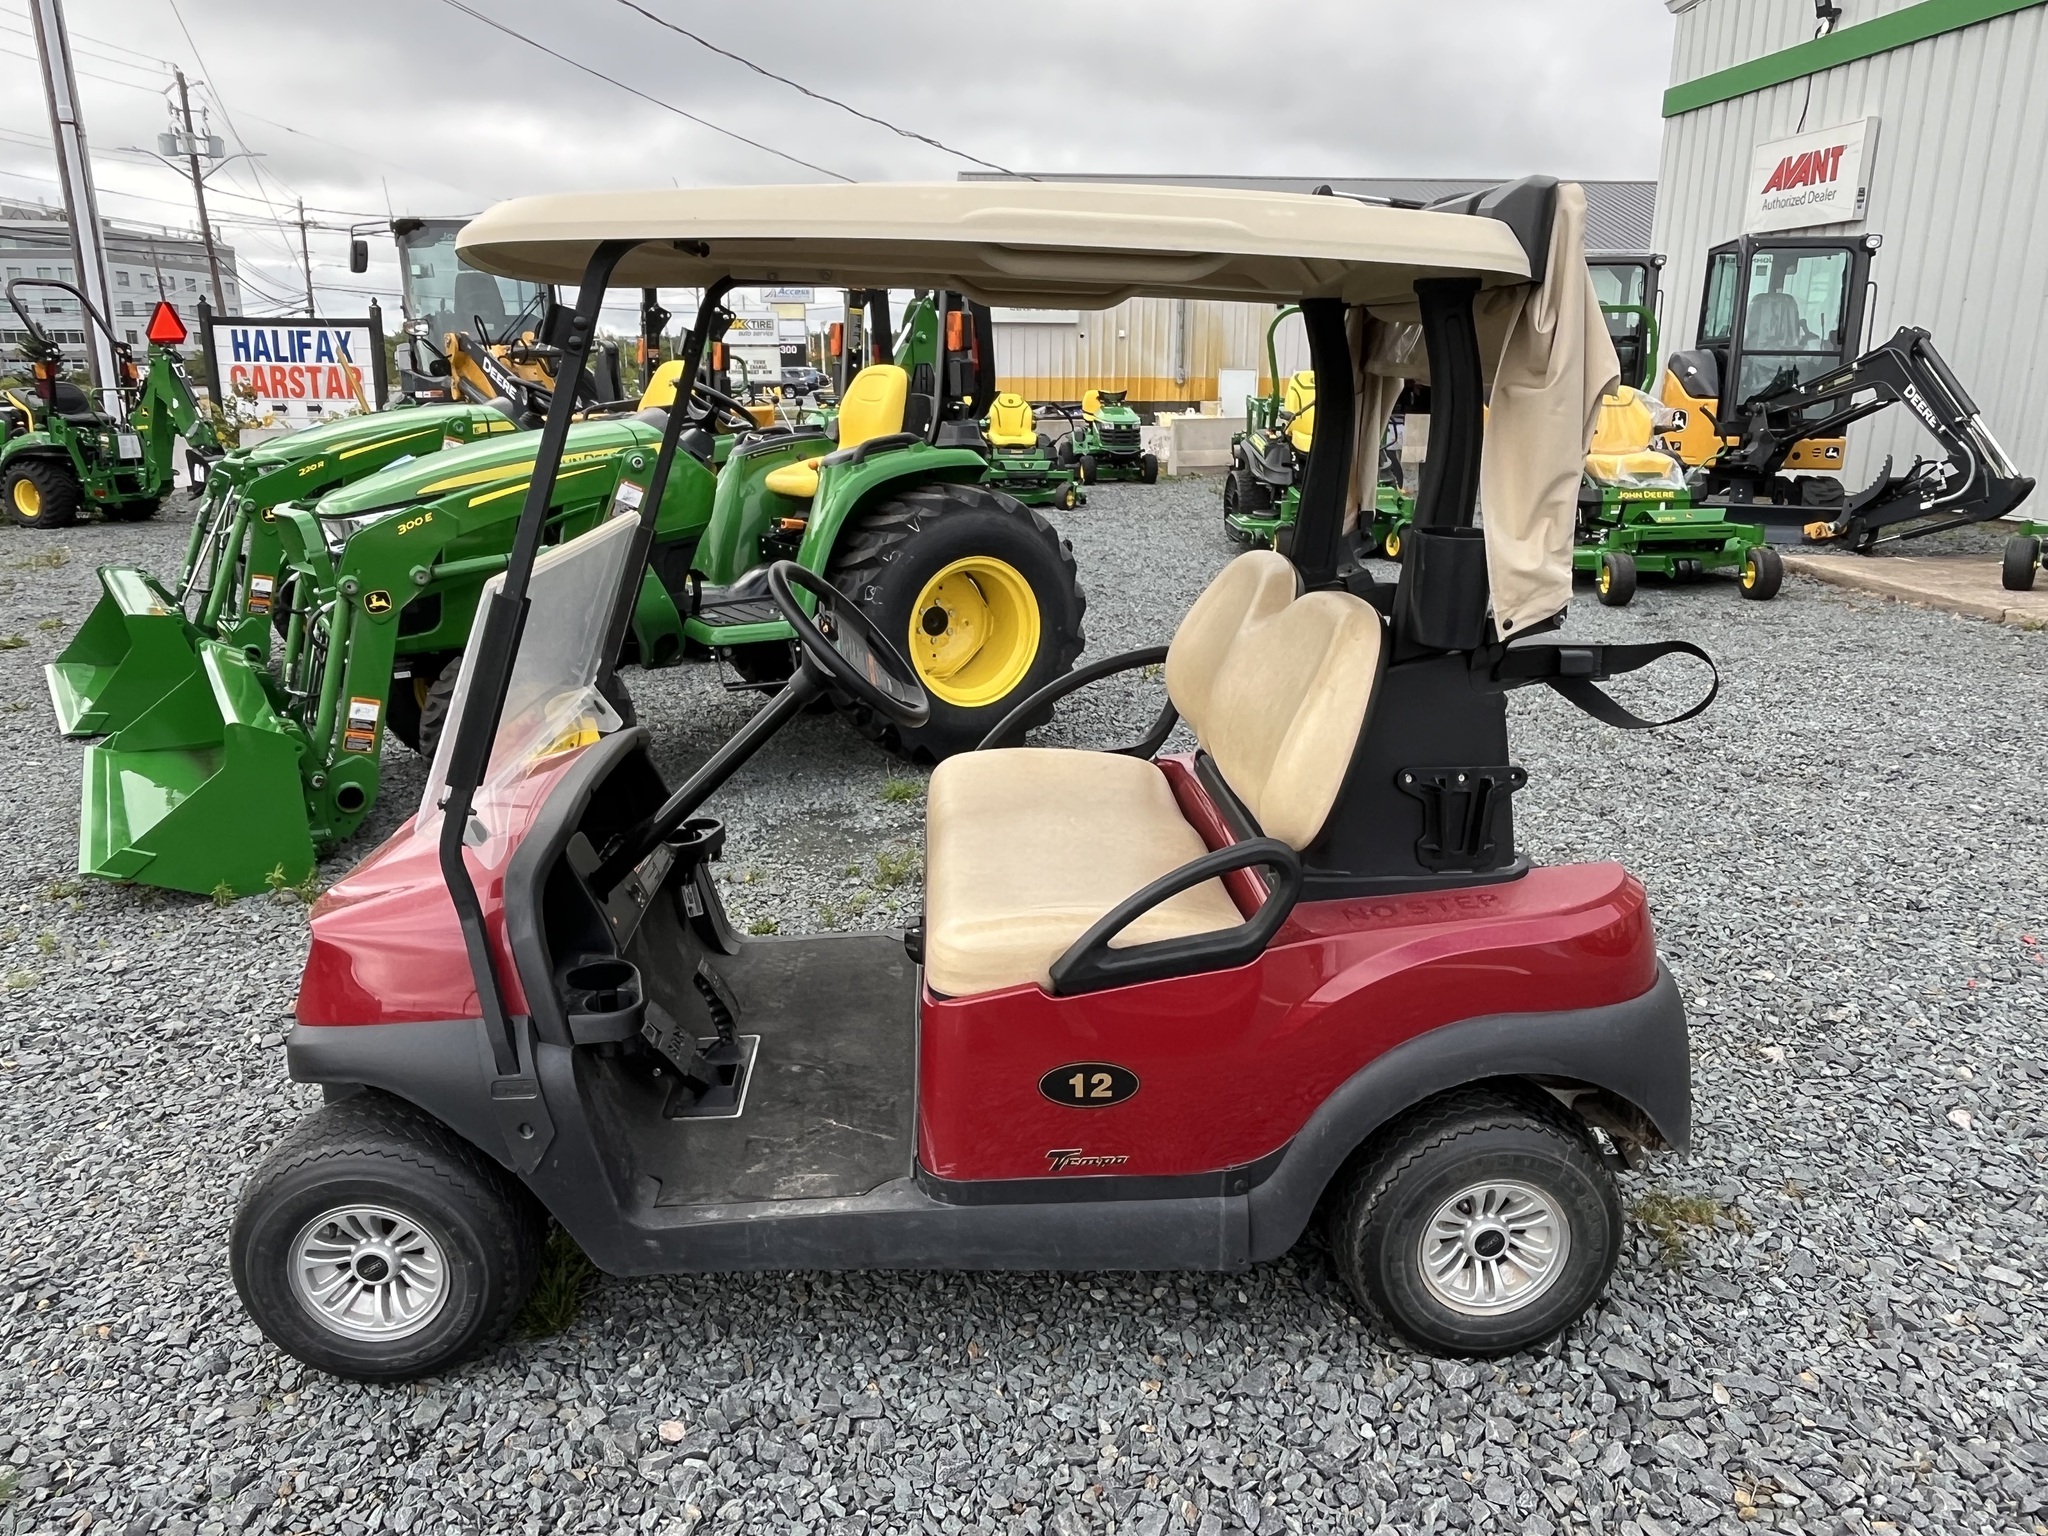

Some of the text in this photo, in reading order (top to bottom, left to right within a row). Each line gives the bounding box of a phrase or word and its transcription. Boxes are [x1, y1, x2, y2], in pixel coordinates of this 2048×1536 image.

[1761, 145, 1845, 195] AVANT
[1762, 192, 1807, 211] Authorized
[1808, 188, 1838, 204] Dealer
[751, 320, 773, 329] TIRE
[231, 329, 354, 364] HALIFAX
[482, 356, 518, 401] DEERE
[1903, 383, 1937, 429] DEERE
[1618, 490, 1675, 500] JOHN DEERE
[1342, 893, 1499, 922] NO STEP
[1068, 1072, 1113, 1099] 12
[1045, 1148, 1130, 1172] Tempo
